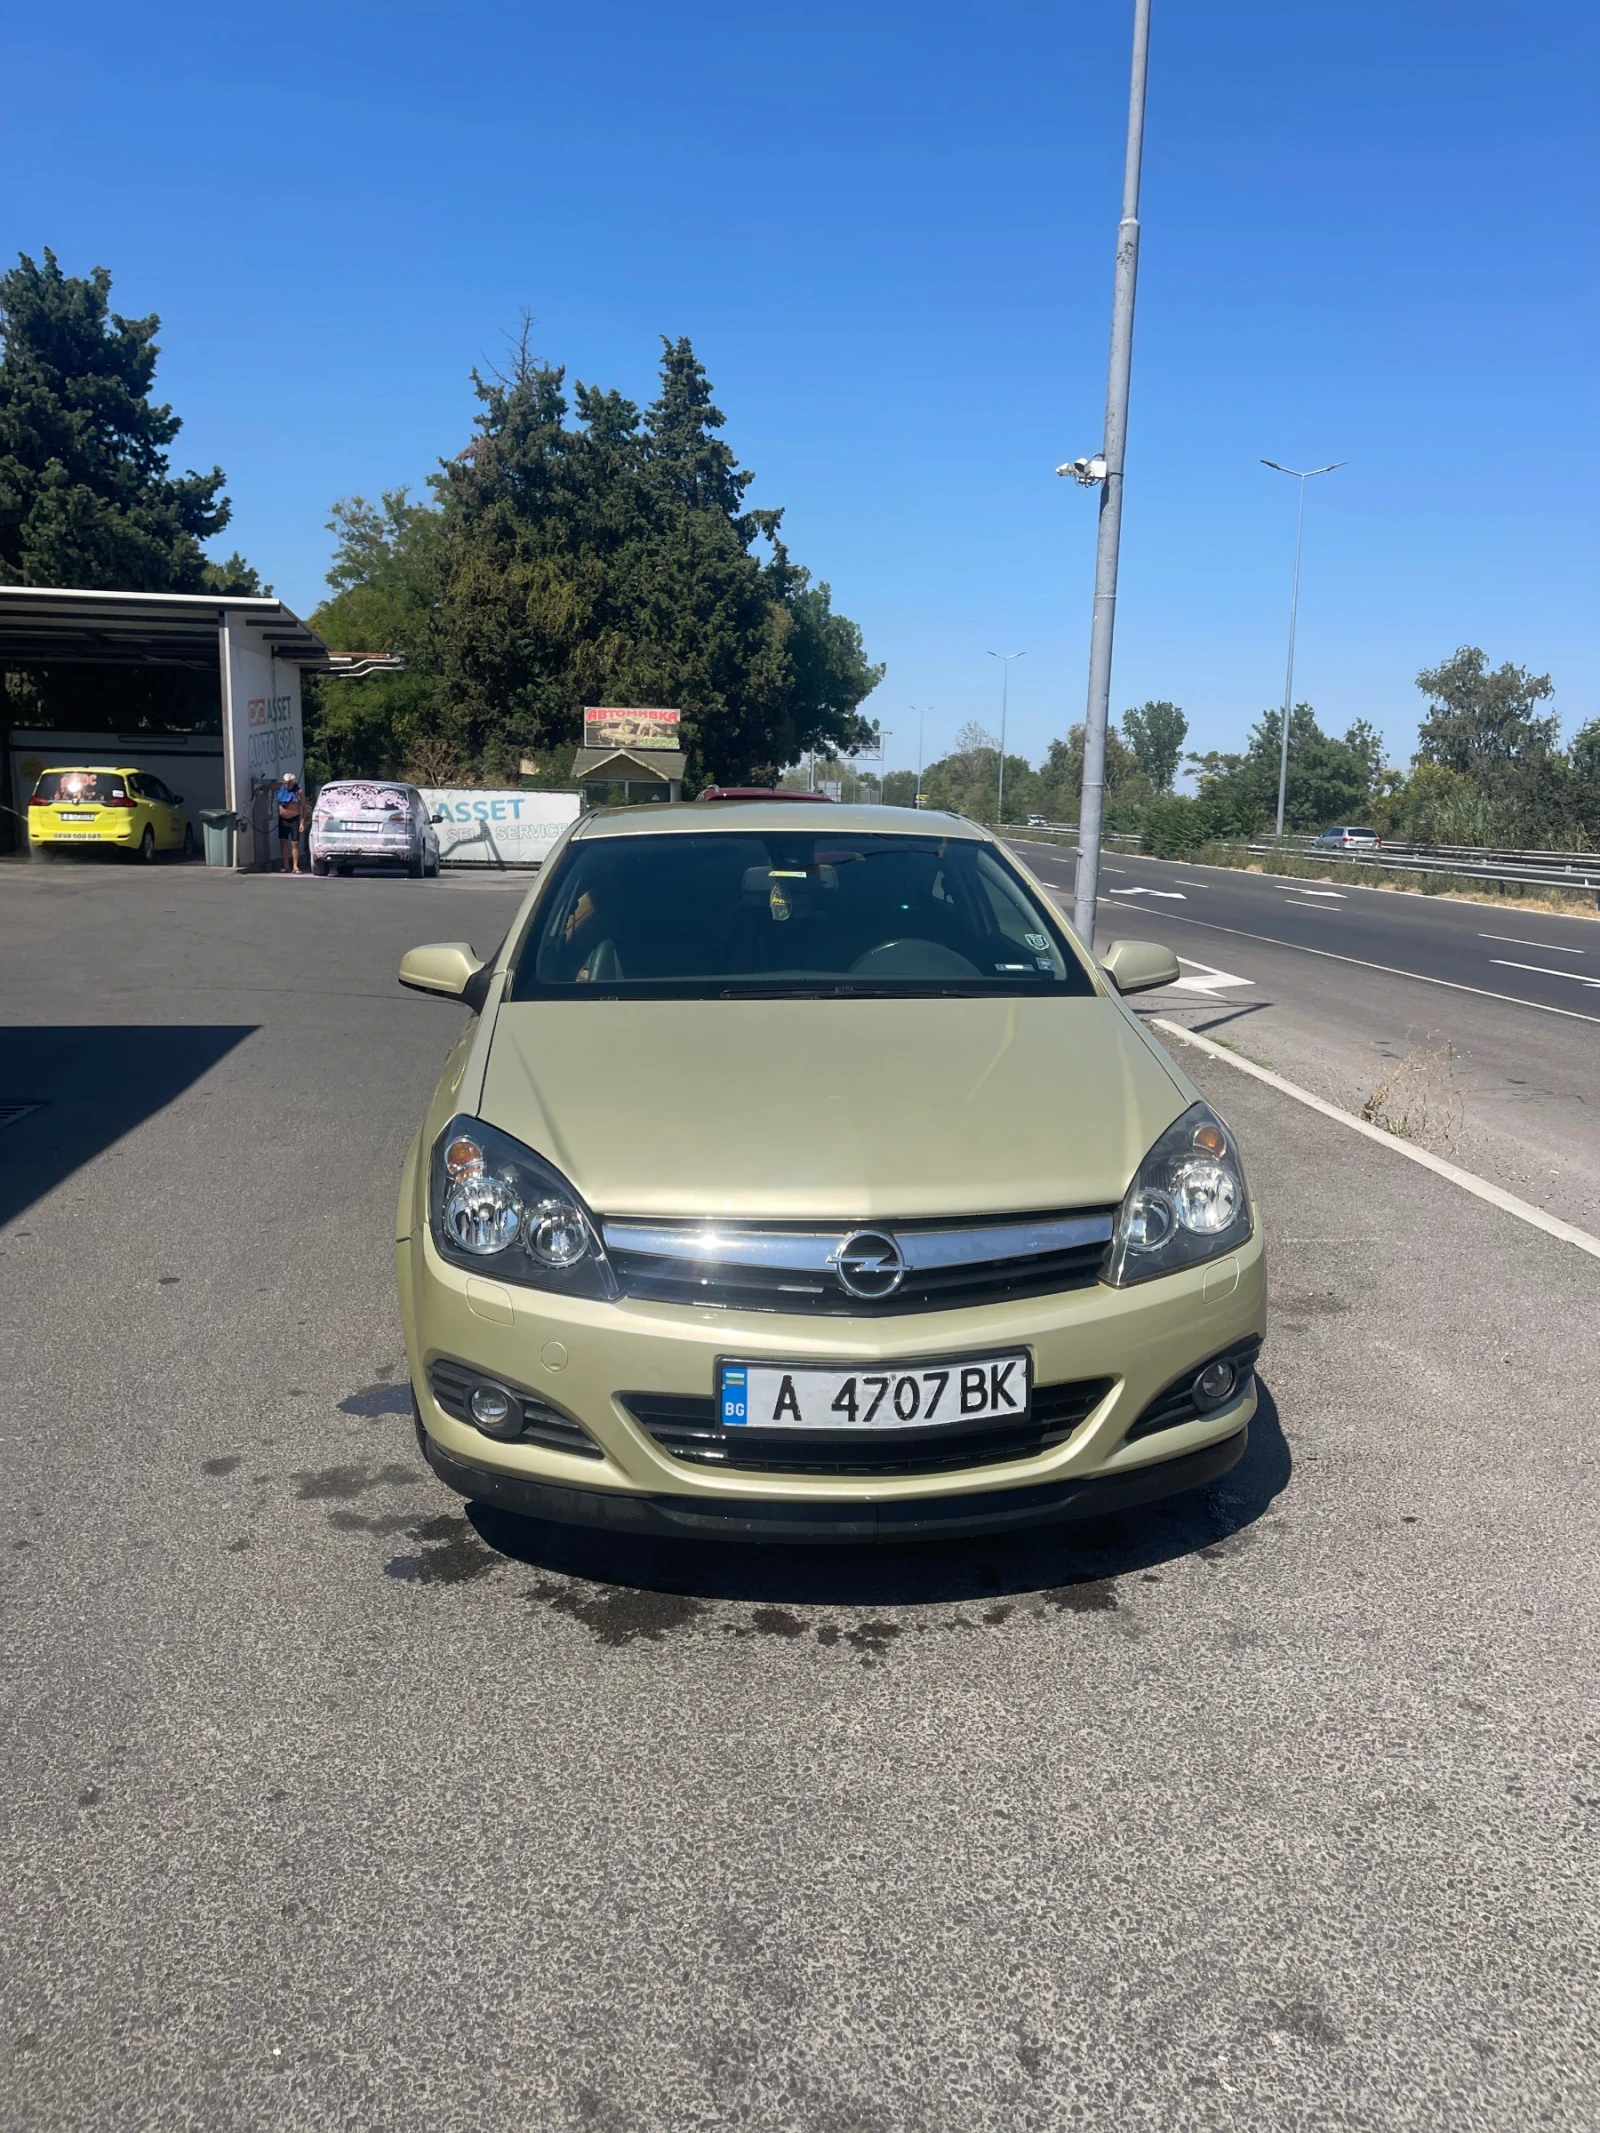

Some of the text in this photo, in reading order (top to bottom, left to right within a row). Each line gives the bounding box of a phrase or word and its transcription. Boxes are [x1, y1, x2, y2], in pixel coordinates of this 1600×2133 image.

[267, 696, 291, 724] ASSET
[587, 710, 678, 723] АВТОМИВКА
[249, 726, 296, 768] AUTO SPA
[436, 799, 525, 823] ASSET
[447, 823, 569, 844] SELF SERVICE
[725, 1361, 1018, 1423] BG A 4707 BK
